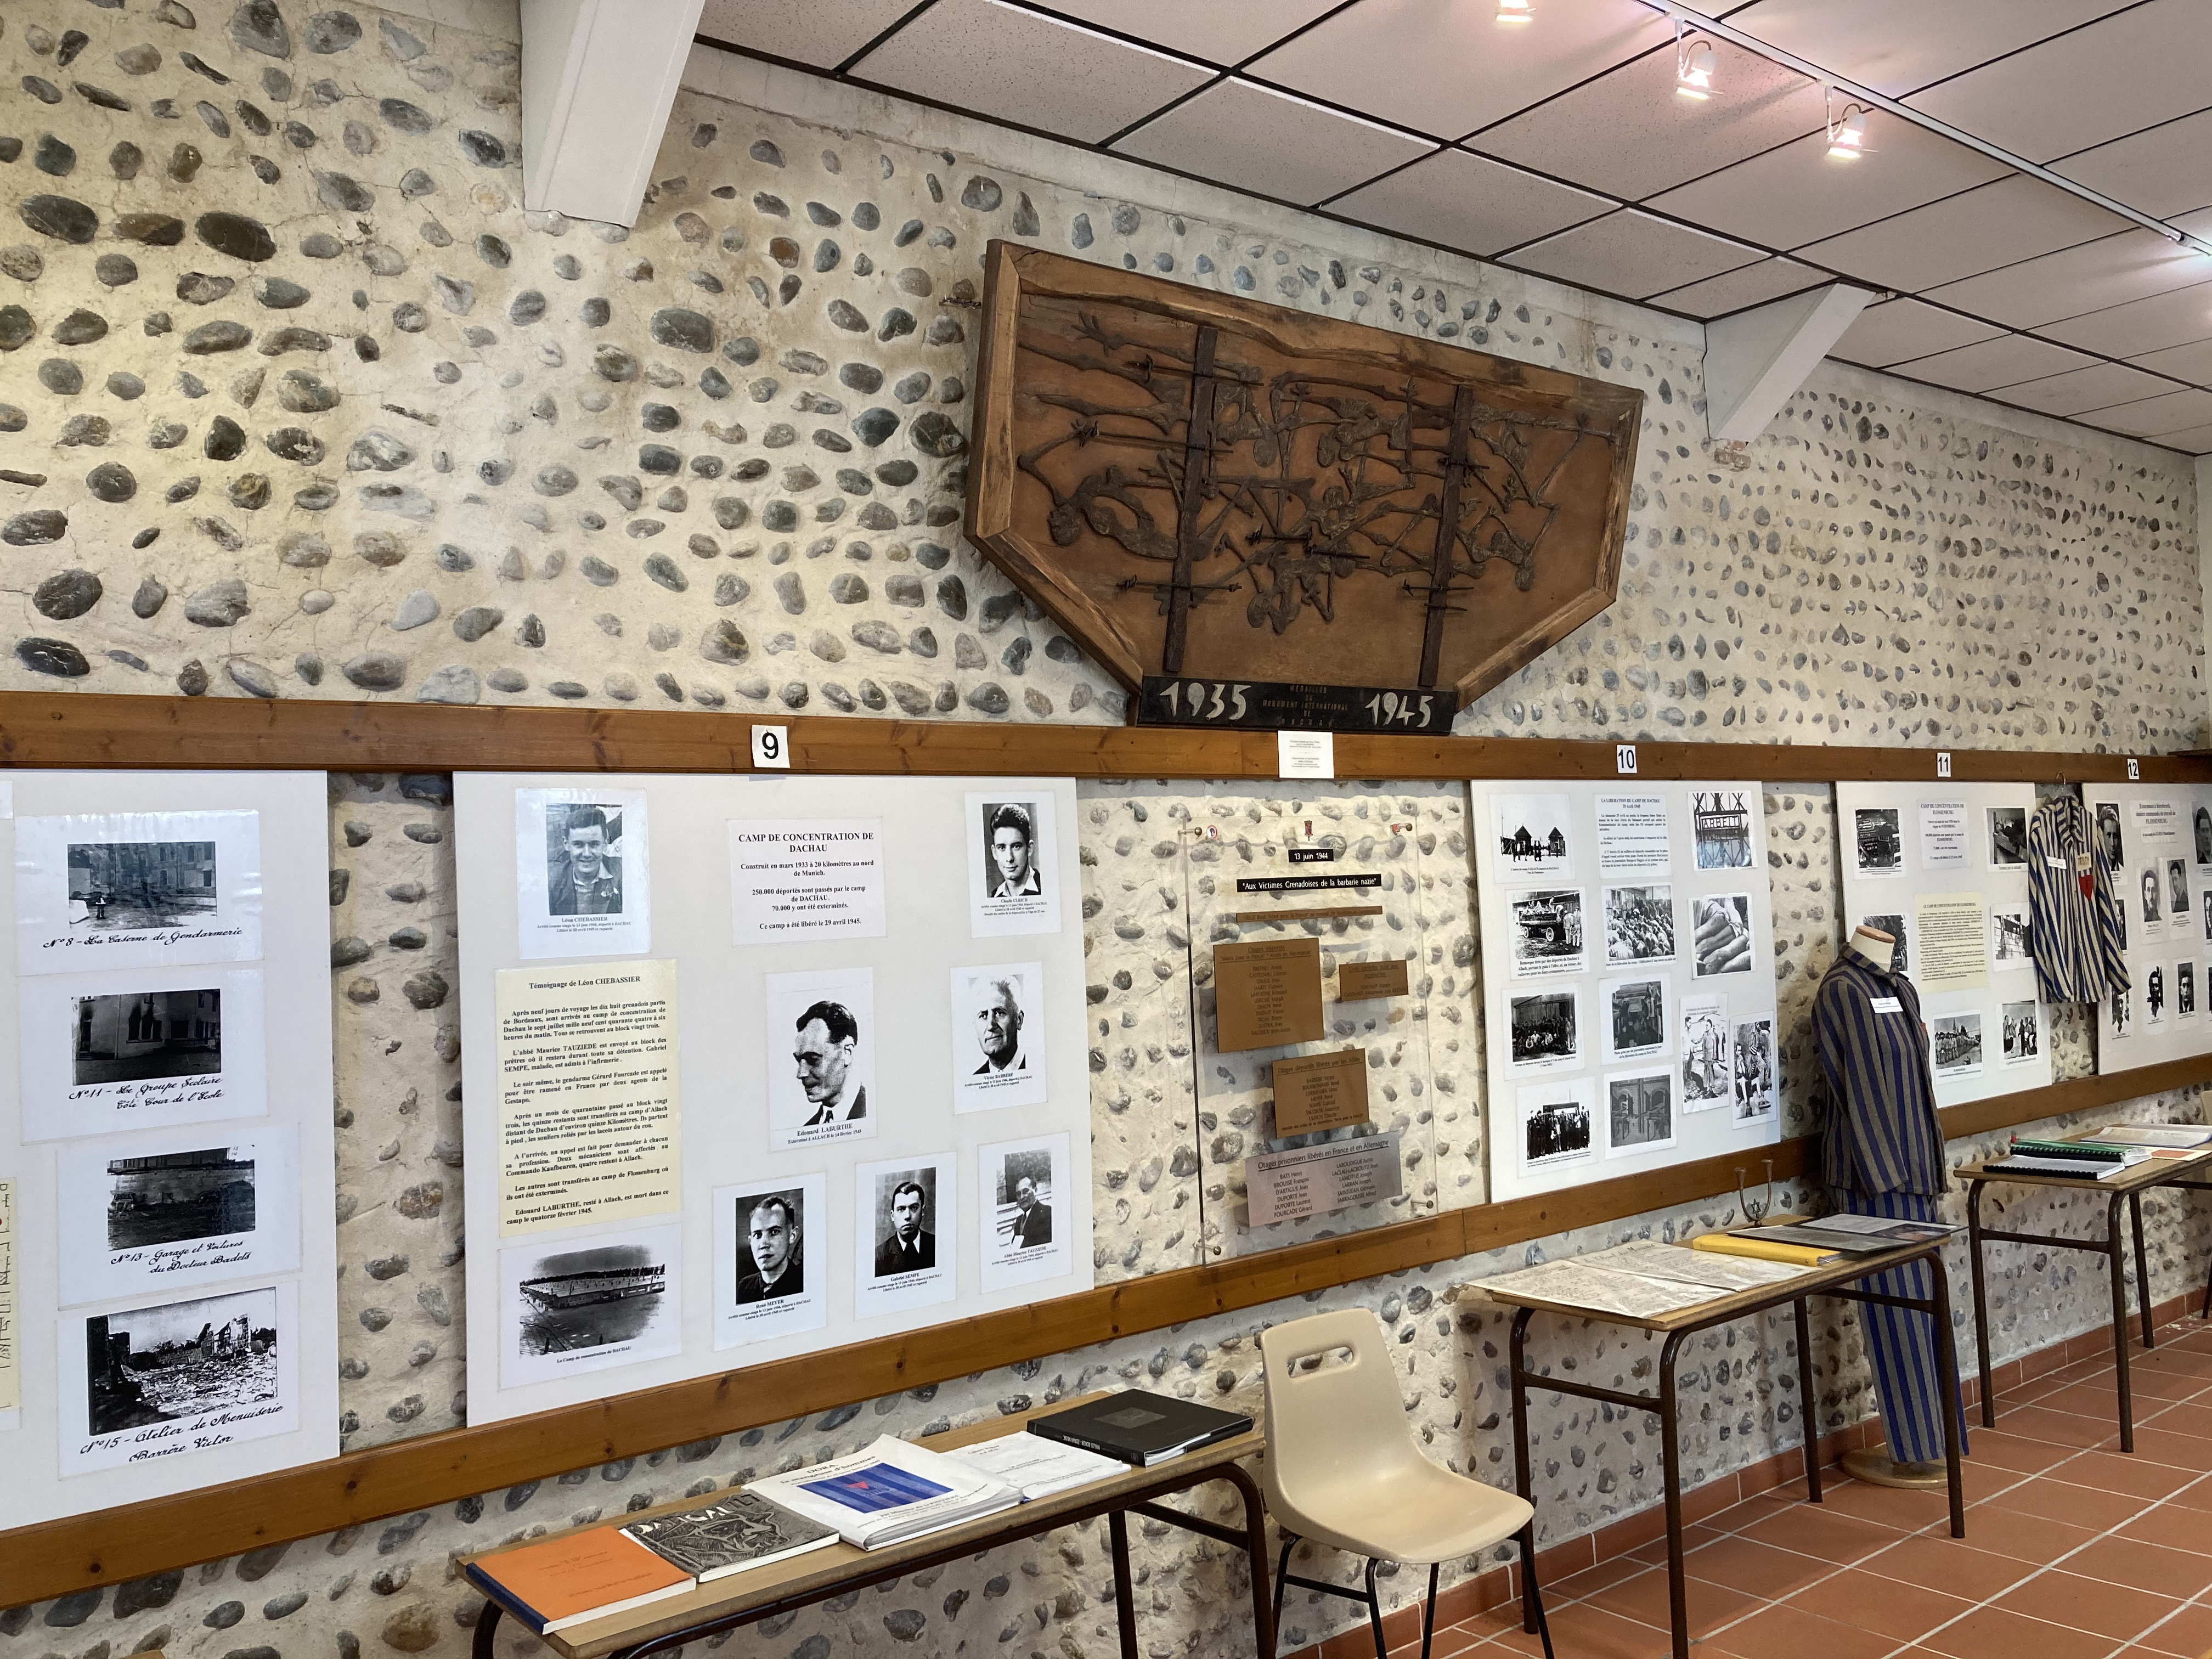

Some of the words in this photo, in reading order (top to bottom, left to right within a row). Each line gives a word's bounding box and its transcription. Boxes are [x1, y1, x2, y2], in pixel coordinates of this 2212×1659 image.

[1160, 681, 1252, 721] 1935
[1365, 692, 1434, 728] 1945
[761, 732, 779, 759] 9
[1618, 749, 1635, 769] 10
[1938, 756, 1949, 772] 11
[2128, 761, 2138, 777] 12
[1704, 817, 1739, 828] ARBEIT
[738, 834, 766, 842] CAMP
[769, 833, 780, 842] DE
[783, 832, 859, 841] CONCENTRATION
[862, 832, 873, 840] DE
[789, 844, 827, 853] DACHAU
[1302, 852, 1313, 861] juin
[776, 887, 800, 895] déportés
[815, 885, 832, 894] passés
[1258, 881, 1283, 889] Victimes
[1285, 879, 1318, 888] Grenadoises
[1320, 878, 1328, 887] de
[1329, 878, 1335, 886] la
[108, 934, 148, 943] Caserne
[153, 933, 167, 941] de
[165, 928, 242, 945] Gendarmerie
[595, 975, 640, 985] CHEBASSIER
[622, 1001, 648, 1009] grenadois
[136, 1081, 177, 1097] Groupe
[181, 1076, 222, 1089] Scolaire
[144, 1097, 169, 1106] Cour
[171, 1094, 184, 1103] de
[821, 1124, 853, 1133] LABURTHE
[1258, 1159, 1277, 1169] Otages
[1278, 1154, 1306, 1165] prisonniers
[1307, 1150, 1324, 1159] libérés
[1333, 1147, 1348, 1155] France
[1363, 1140, 1389, 1149] Allemagne
[149, 1249, 189, 1265] Garage
[191, 1243, 204, 1253] et
[150, 1262, 165, 1273] du
[167, 1259, 208, 1271] Docteur
[134, 1425, 184, 1442] Atelier
[188, 1417, 206, 1431] de
[210, 1406, 283, 1426] Menuiserie
[128, 1444, 187, 1462] Barrère
[193, 1434, 234, 1449] Victor
